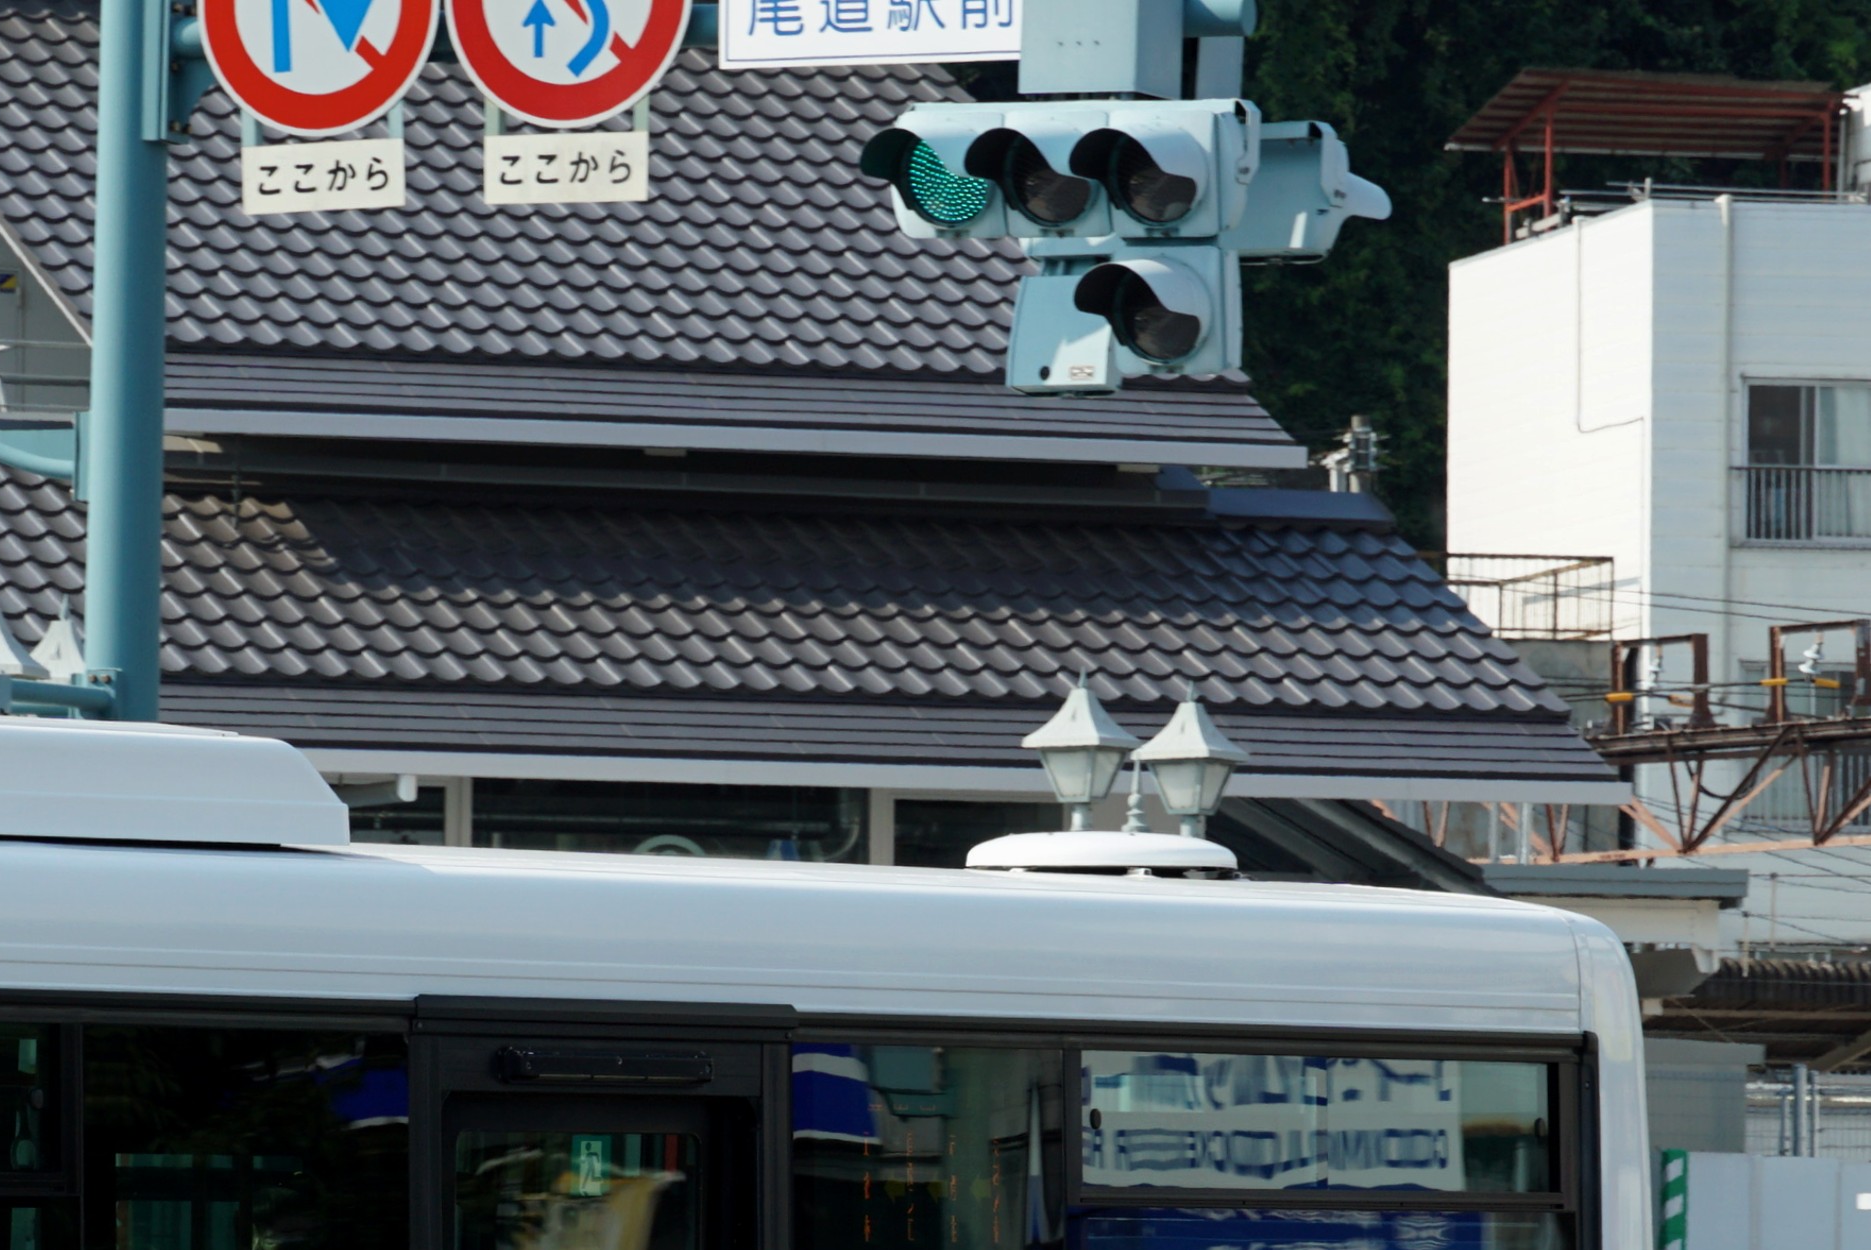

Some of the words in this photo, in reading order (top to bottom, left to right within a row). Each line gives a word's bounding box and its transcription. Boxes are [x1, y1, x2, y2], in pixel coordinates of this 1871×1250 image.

[258, 155, 390, 196] ここから
[499, 149, 632, 186] ここから
